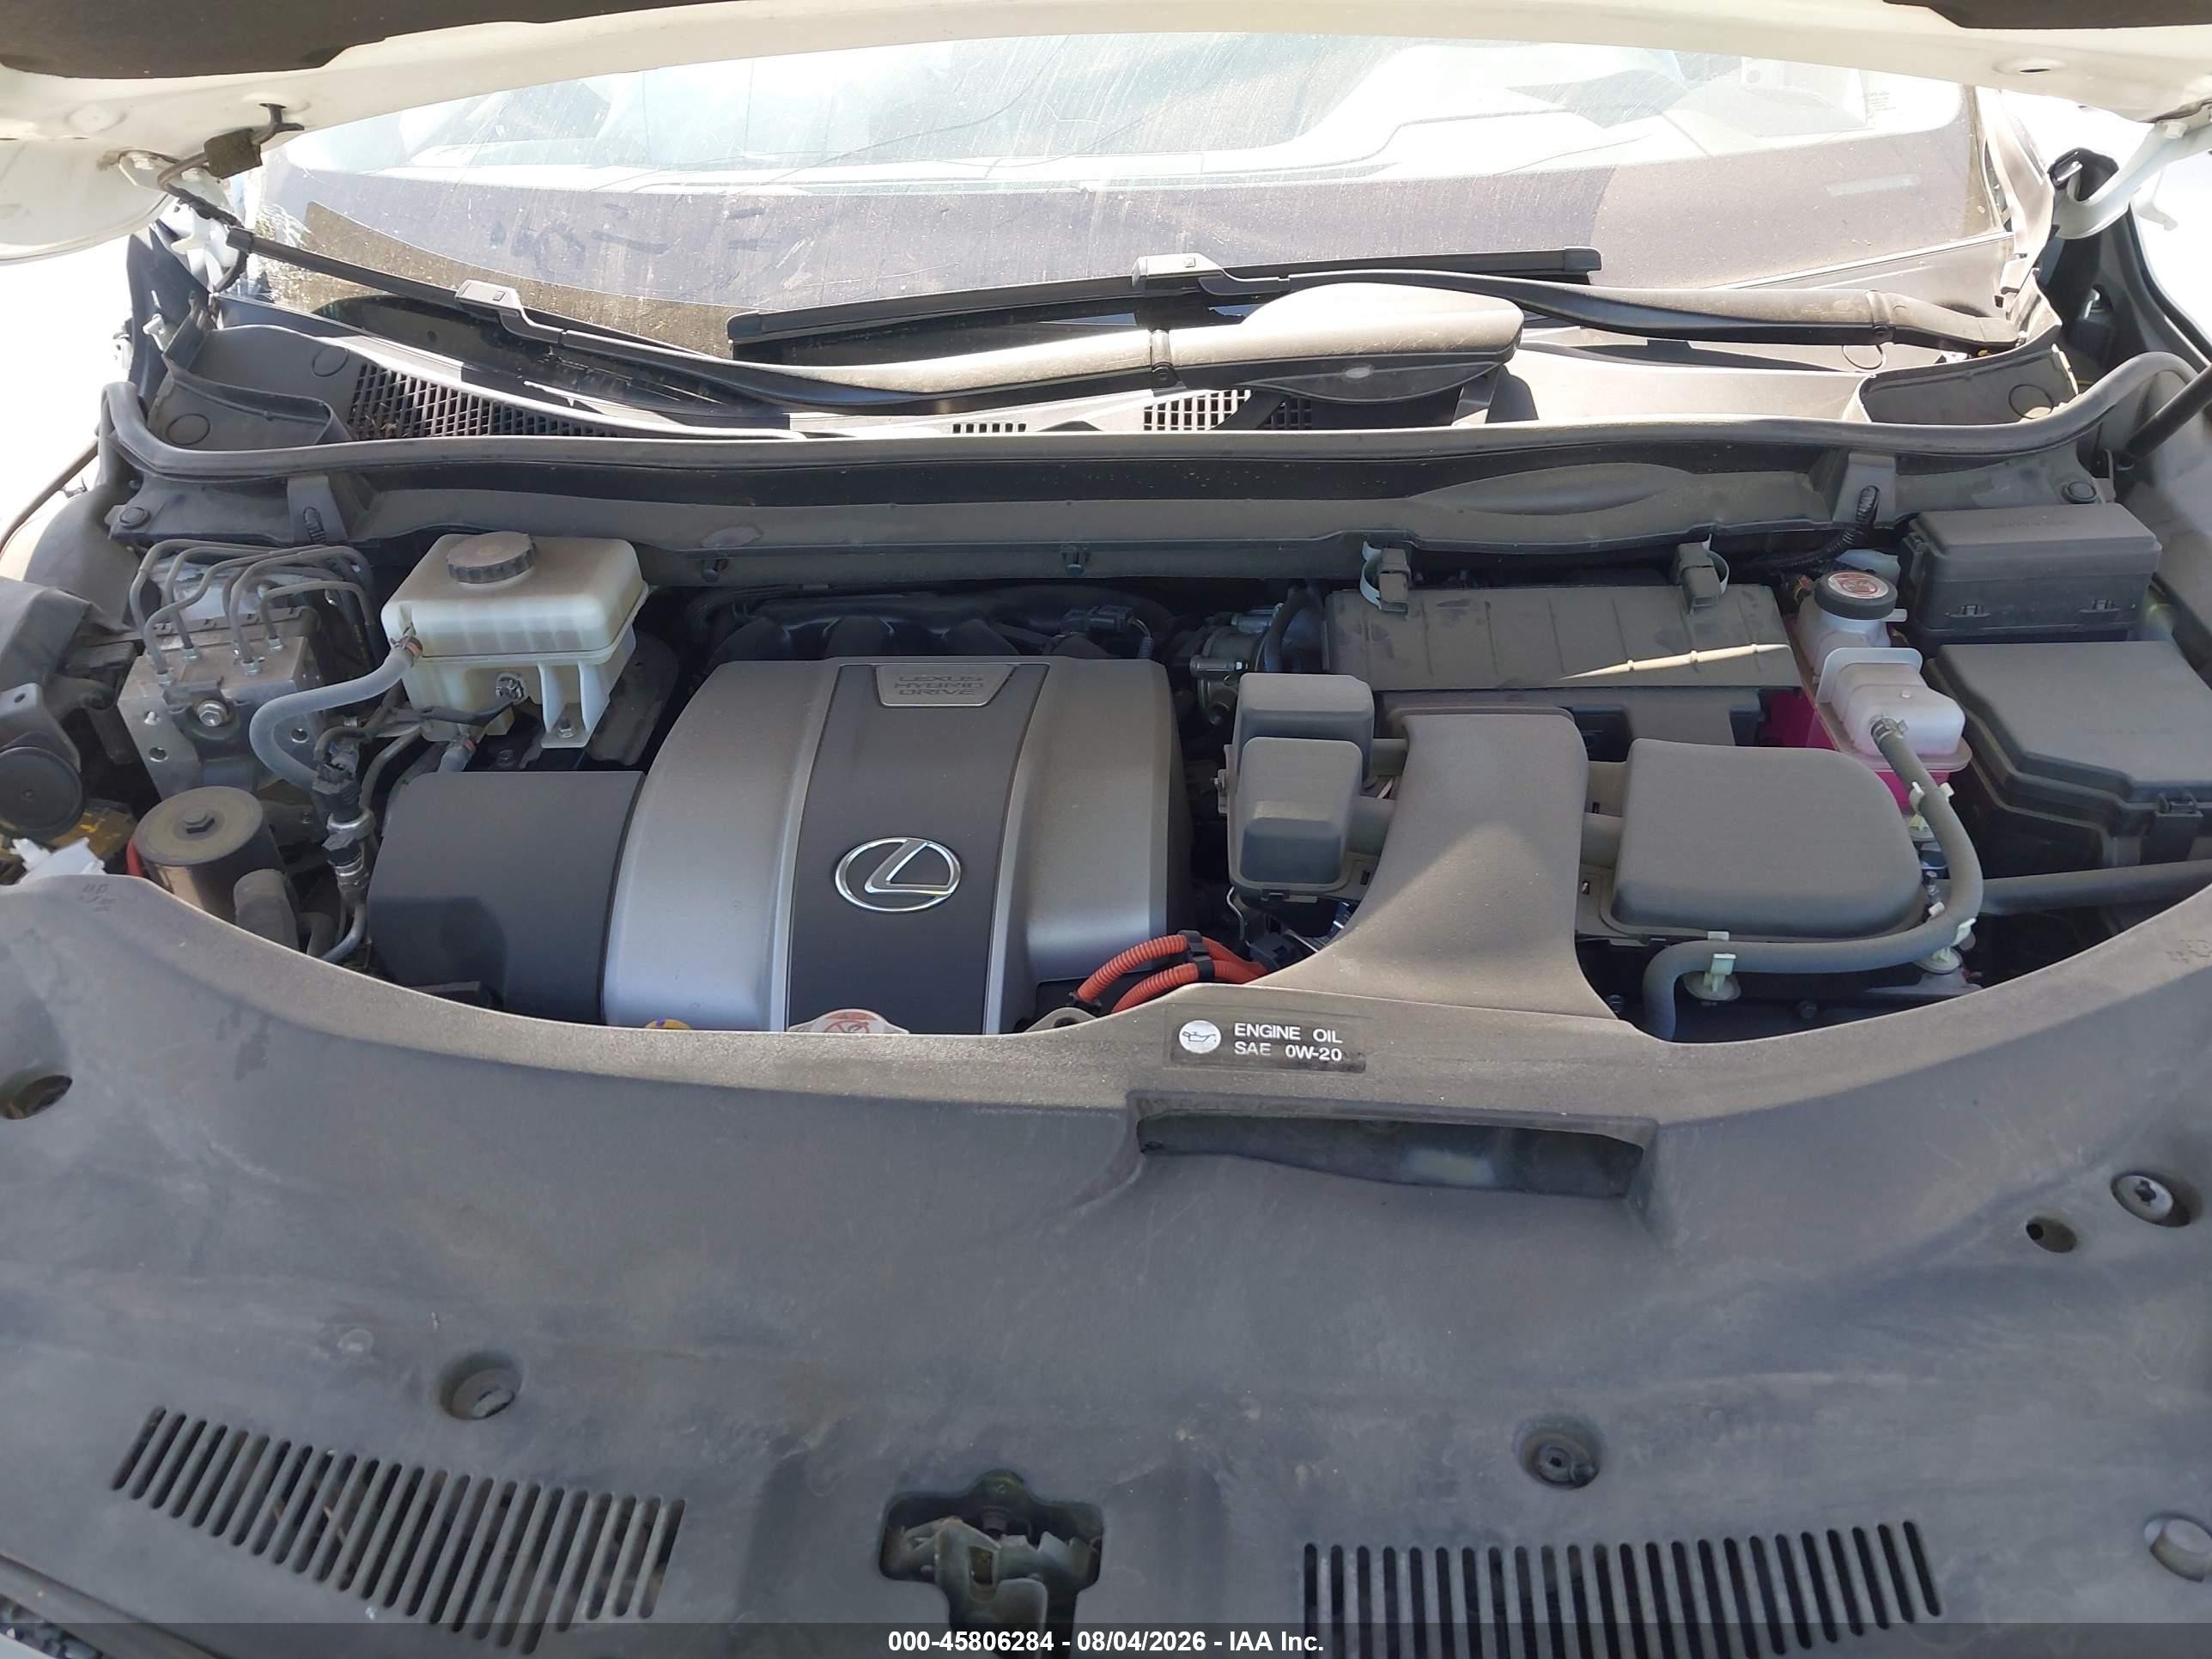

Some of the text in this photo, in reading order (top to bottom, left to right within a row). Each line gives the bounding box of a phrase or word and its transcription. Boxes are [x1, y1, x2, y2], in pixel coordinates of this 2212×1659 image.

[1234, 1022, 1344, 1044] ENGINE OIL
[1234, 1040, 1343, 1062] SAE 0W-20
